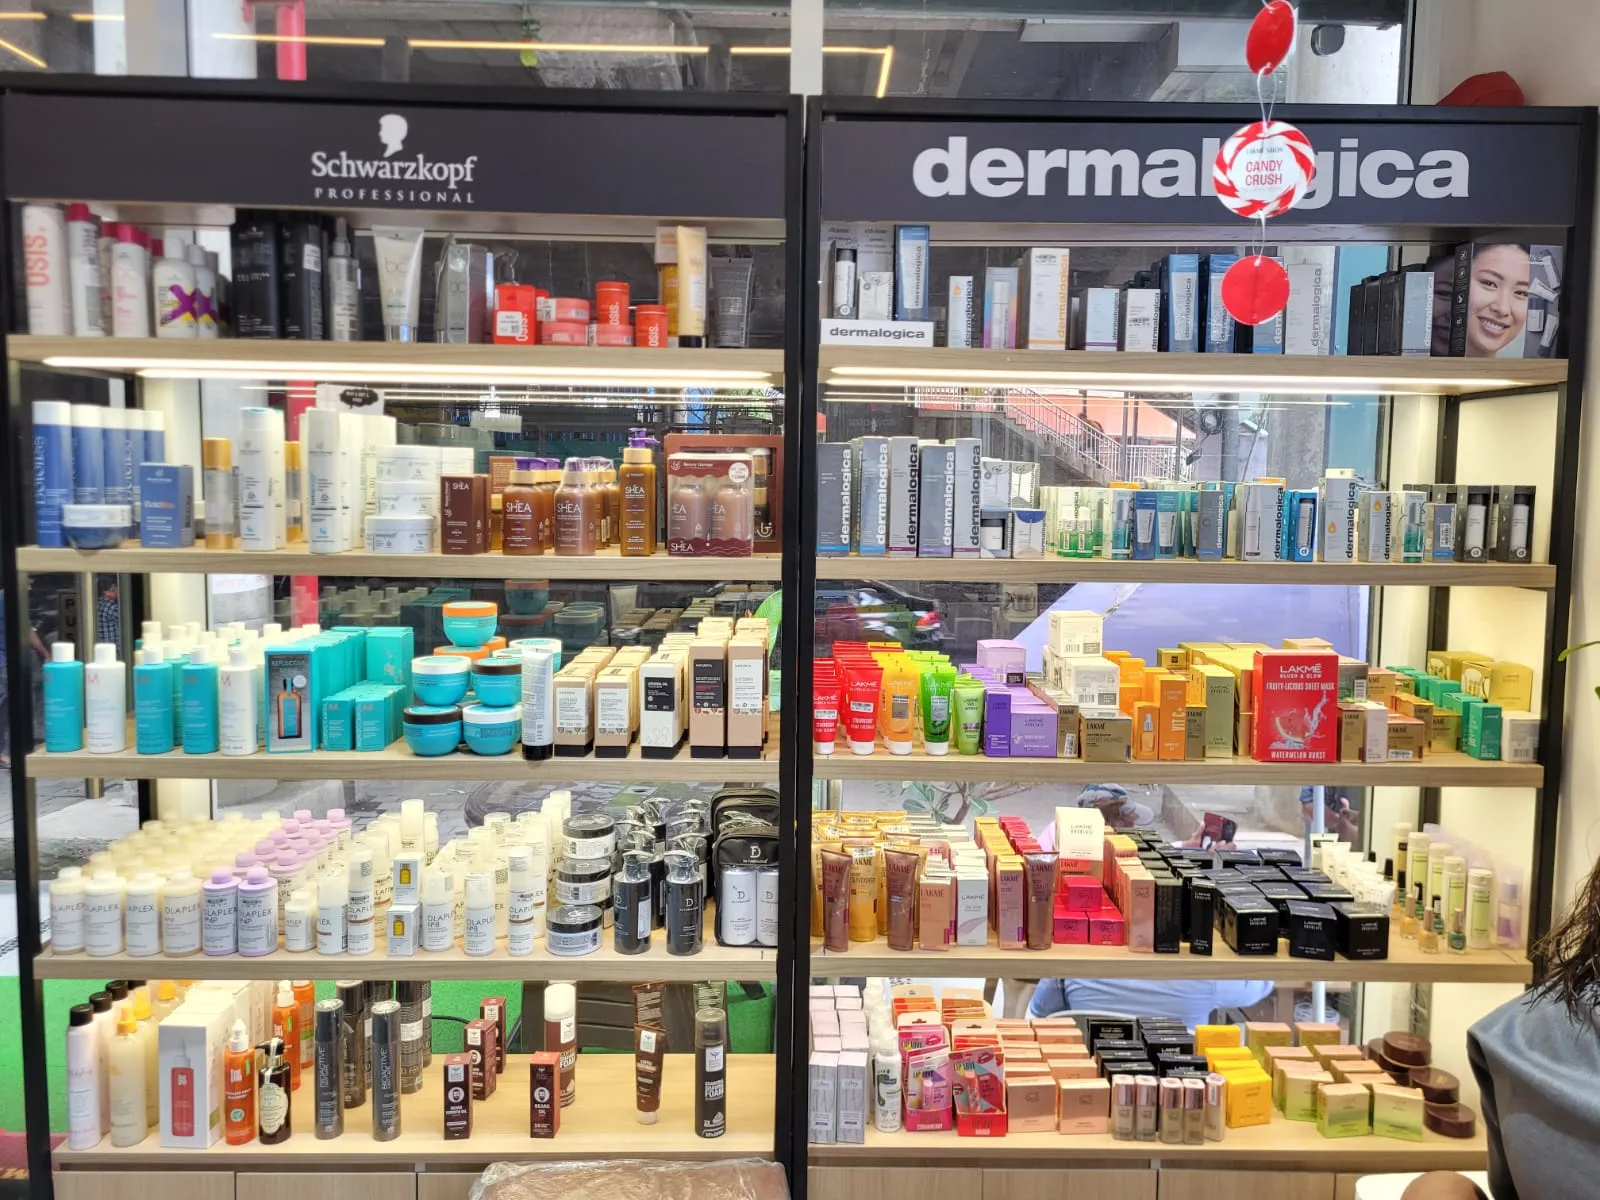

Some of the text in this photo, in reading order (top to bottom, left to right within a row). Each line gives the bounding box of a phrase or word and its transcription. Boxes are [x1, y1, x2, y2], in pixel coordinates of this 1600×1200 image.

[311, 151, 478, 189] Schwarzkopf
[314, 187, 475, 203] PROFESSIONAL
[912, 136, 1470, 210] dermalgica
[1245, 160, 1283, 173] CANDY
[1245, 174, 1283, 186] CRUSH
[829, 327, 926, 340] dermalogica
[964, 280, 973, 346] dermalogica
[1311, 268, 1322, 347] dermalogica
[506, 501, 532, 513] SHEA
[556, 501, 582, 514] SHEA
[625, 484, 645, 494] SHEA
[840, 449, 851, 544] dermalogica
[876, 443, 888, 545] dermalogica
[906, 443, 918, 545] dermalogica
[943, 451, 954, 546] dermalogica
[969, 445, 981, 546] dermalogica
[1346, 481, 1355, 559] dermalogica
[671, 541, 694, 552] SHEA
[1273, 487, 1284, 560] dermalogica
[1383, 495, 1391, 560] dermalogica
[1280, 663, 1322, 673] LAKMÉ
